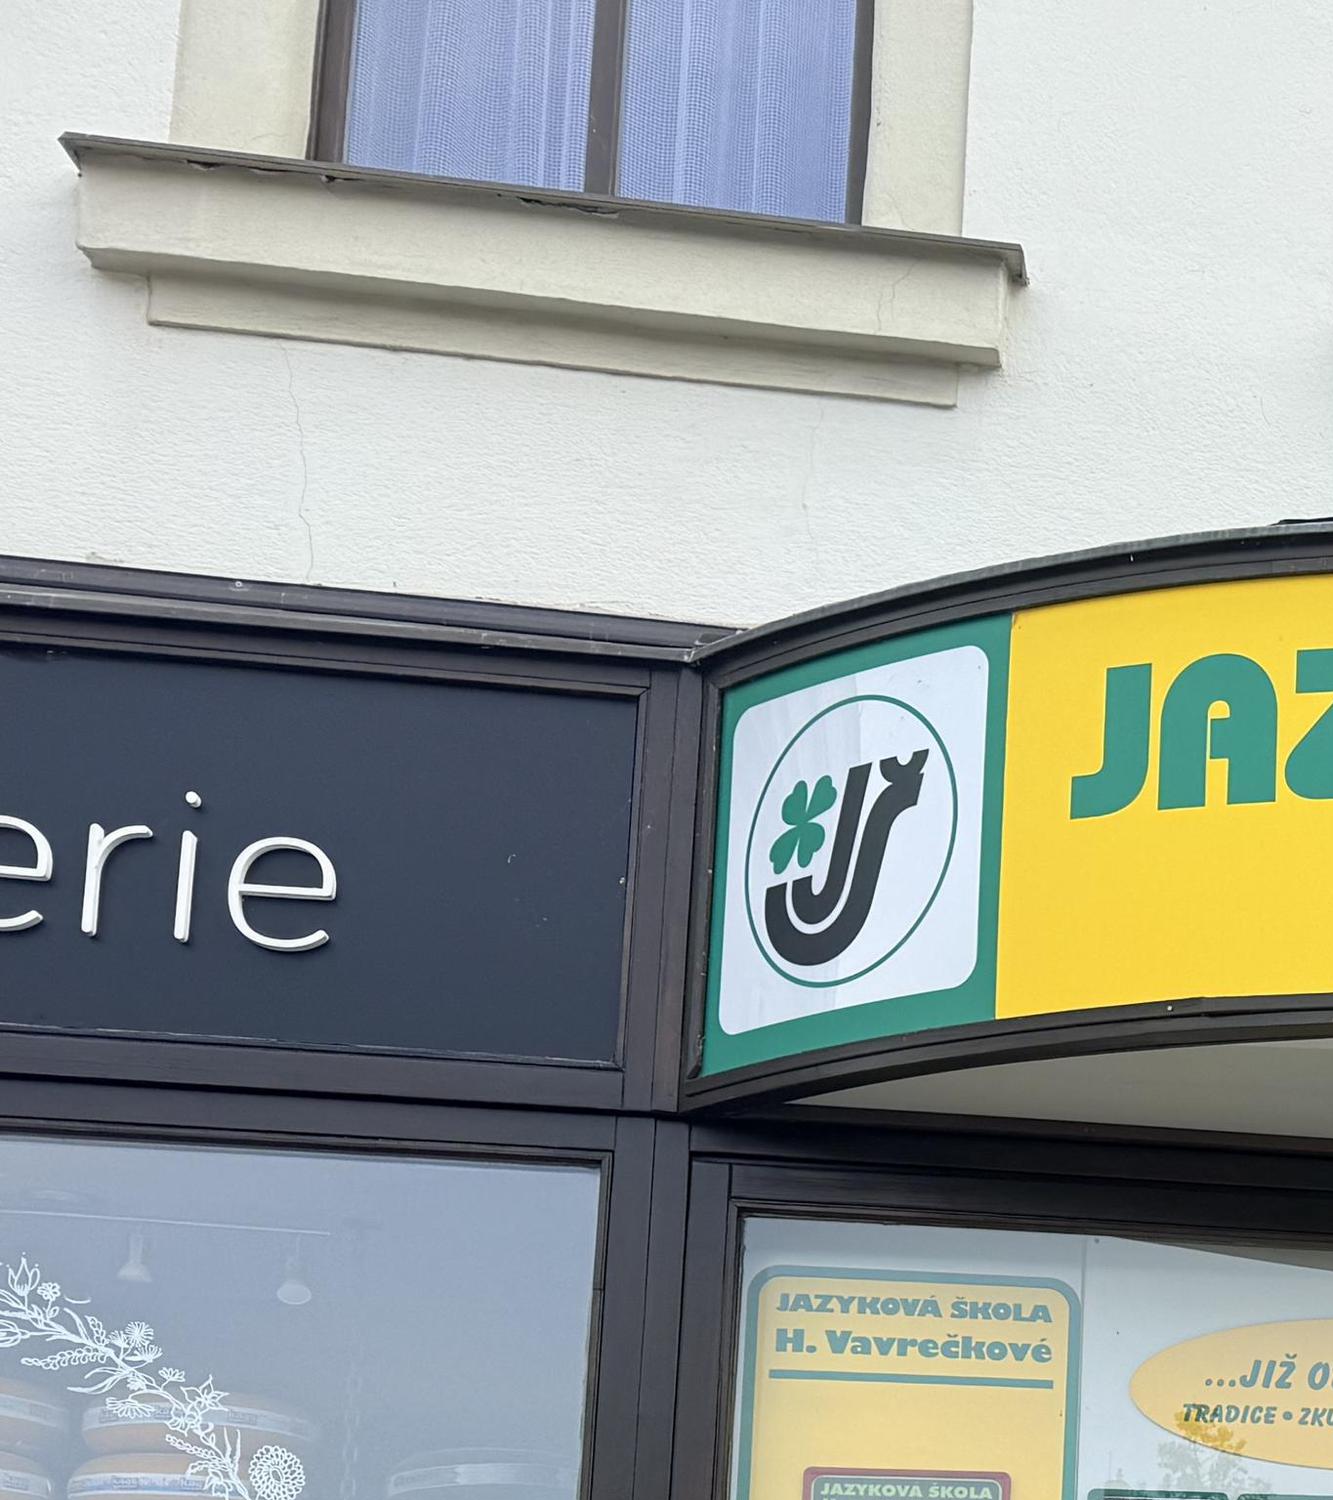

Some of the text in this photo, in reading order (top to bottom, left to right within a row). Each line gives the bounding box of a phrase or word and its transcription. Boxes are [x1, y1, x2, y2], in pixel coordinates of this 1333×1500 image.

[776, 1293, 1053, 1323] JAZYKOVÁ ŠKOLA
[776, 1328, 1052, 1363] H. Vavrečkové
[1182, 1403, 1277, 1424] TRADICE
[820, 1481, 993, 1500] JAZYKOVÁ ŠKOLA
